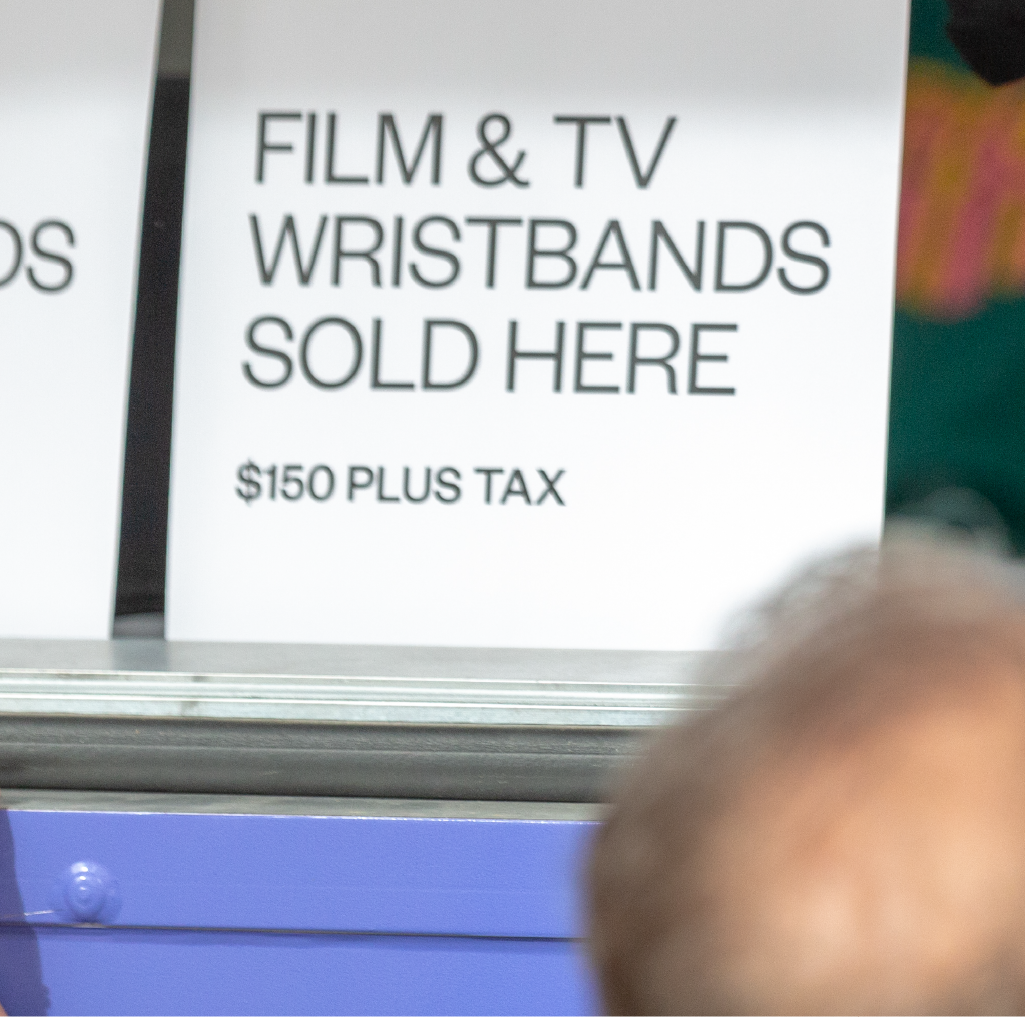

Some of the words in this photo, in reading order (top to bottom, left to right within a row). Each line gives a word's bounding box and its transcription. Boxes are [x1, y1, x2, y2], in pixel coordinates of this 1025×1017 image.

[254, 110, 445, 186] FILM
[467, 111, 531, 189] &
[553, 114, 678, 189] TV
[248, 213, 834, 297] WRISTBANDS
[242, 315, 480, 392] SOLD
[505, 319, 739, 397] HERE
[235, 459, 335, 505] $150
[346, 465, 463, 506] PLUS
[474, 467, 567, 508] TAX
